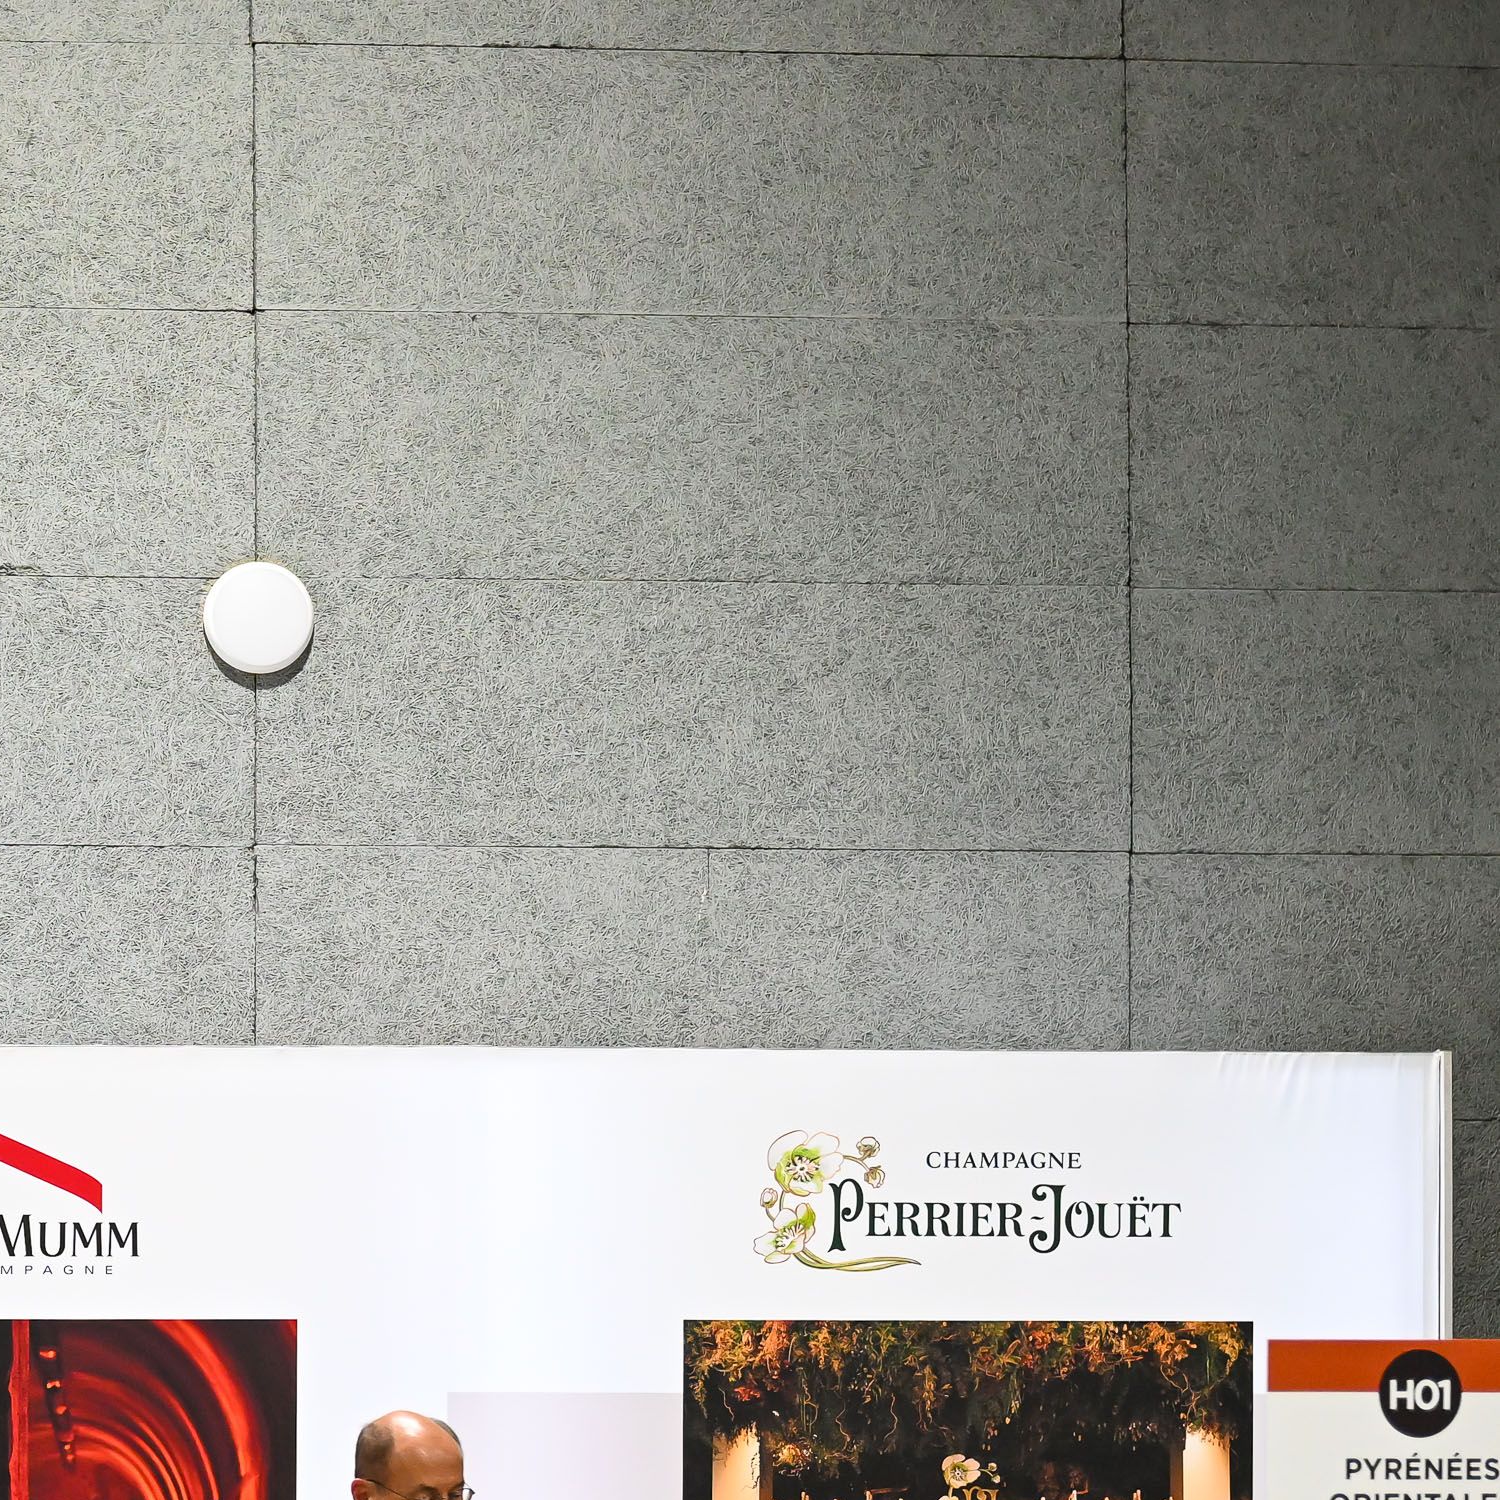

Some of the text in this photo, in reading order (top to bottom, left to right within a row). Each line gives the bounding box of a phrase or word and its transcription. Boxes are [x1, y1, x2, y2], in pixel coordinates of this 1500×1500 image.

[926, 1151, 1082, 1169] CHAMPAGNE
[1388, 1379, 1452, 1411] H01
[1345, 1452, 1500, 1481] PYRÉNÉES
